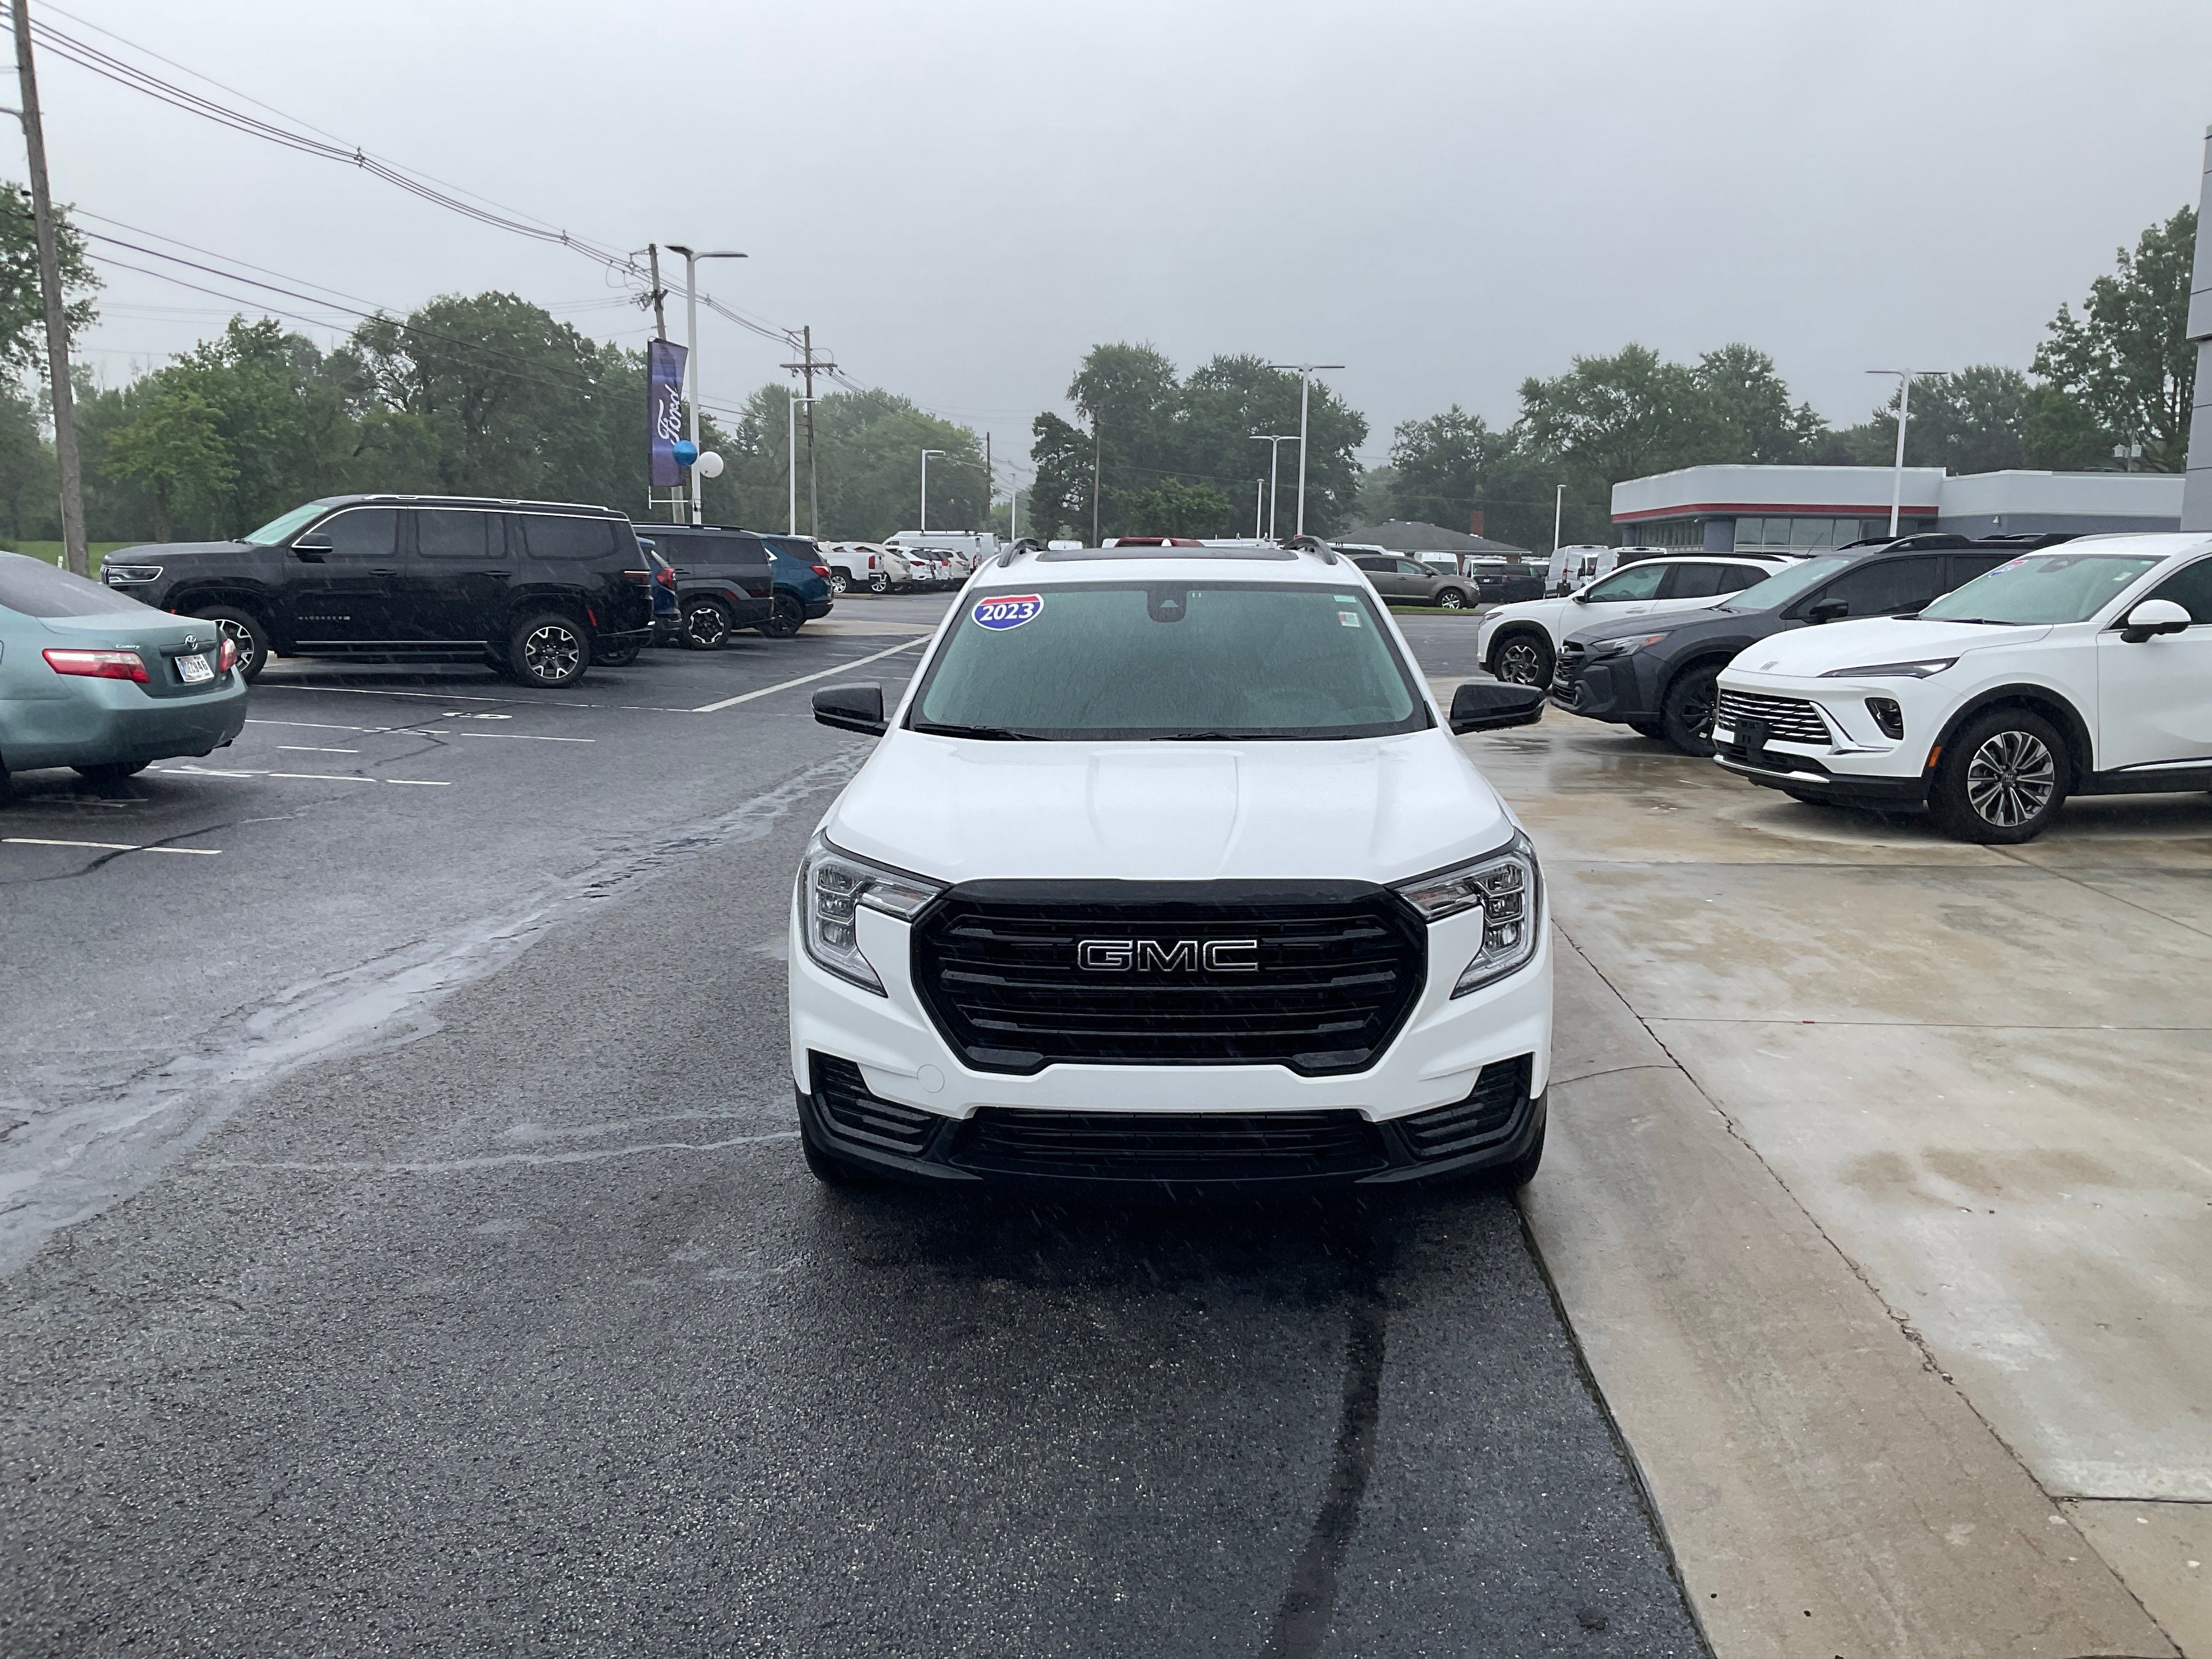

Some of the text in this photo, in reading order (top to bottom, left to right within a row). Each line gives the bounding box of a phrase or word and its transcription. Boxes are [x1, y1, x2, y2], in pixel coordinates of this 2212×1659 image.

[657, 383, 682, 446] Ford
[979, 603, 1035, 621] 2023
[1077, 940, 1259, 972] GMC
